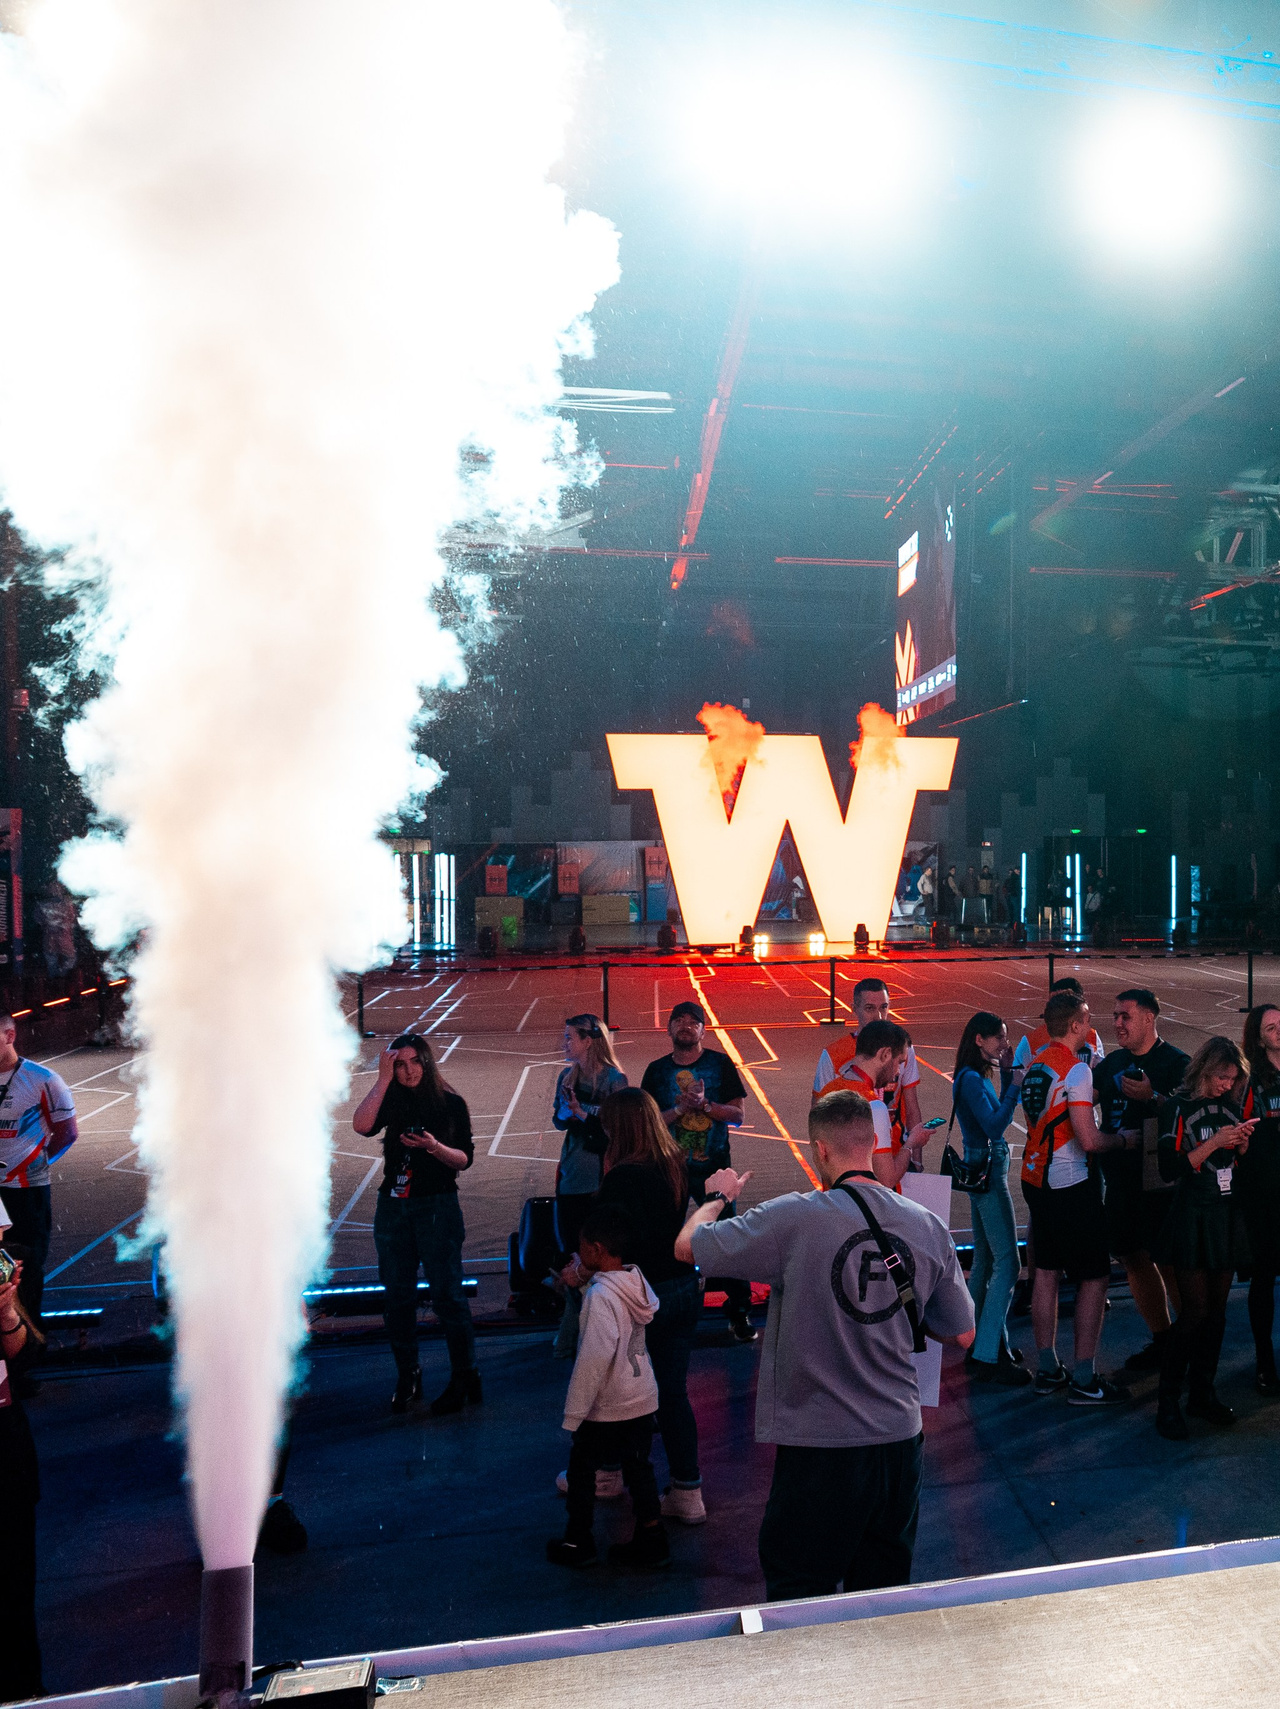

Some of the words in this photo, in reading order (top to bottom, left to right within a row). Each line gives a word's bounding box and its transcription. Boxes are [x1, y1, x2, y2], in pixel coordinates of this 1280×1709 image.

[605, 733, 959, 945] W
[397, 1175, 408, 1184] VIP
[858, 1251, 888, 1302] F
